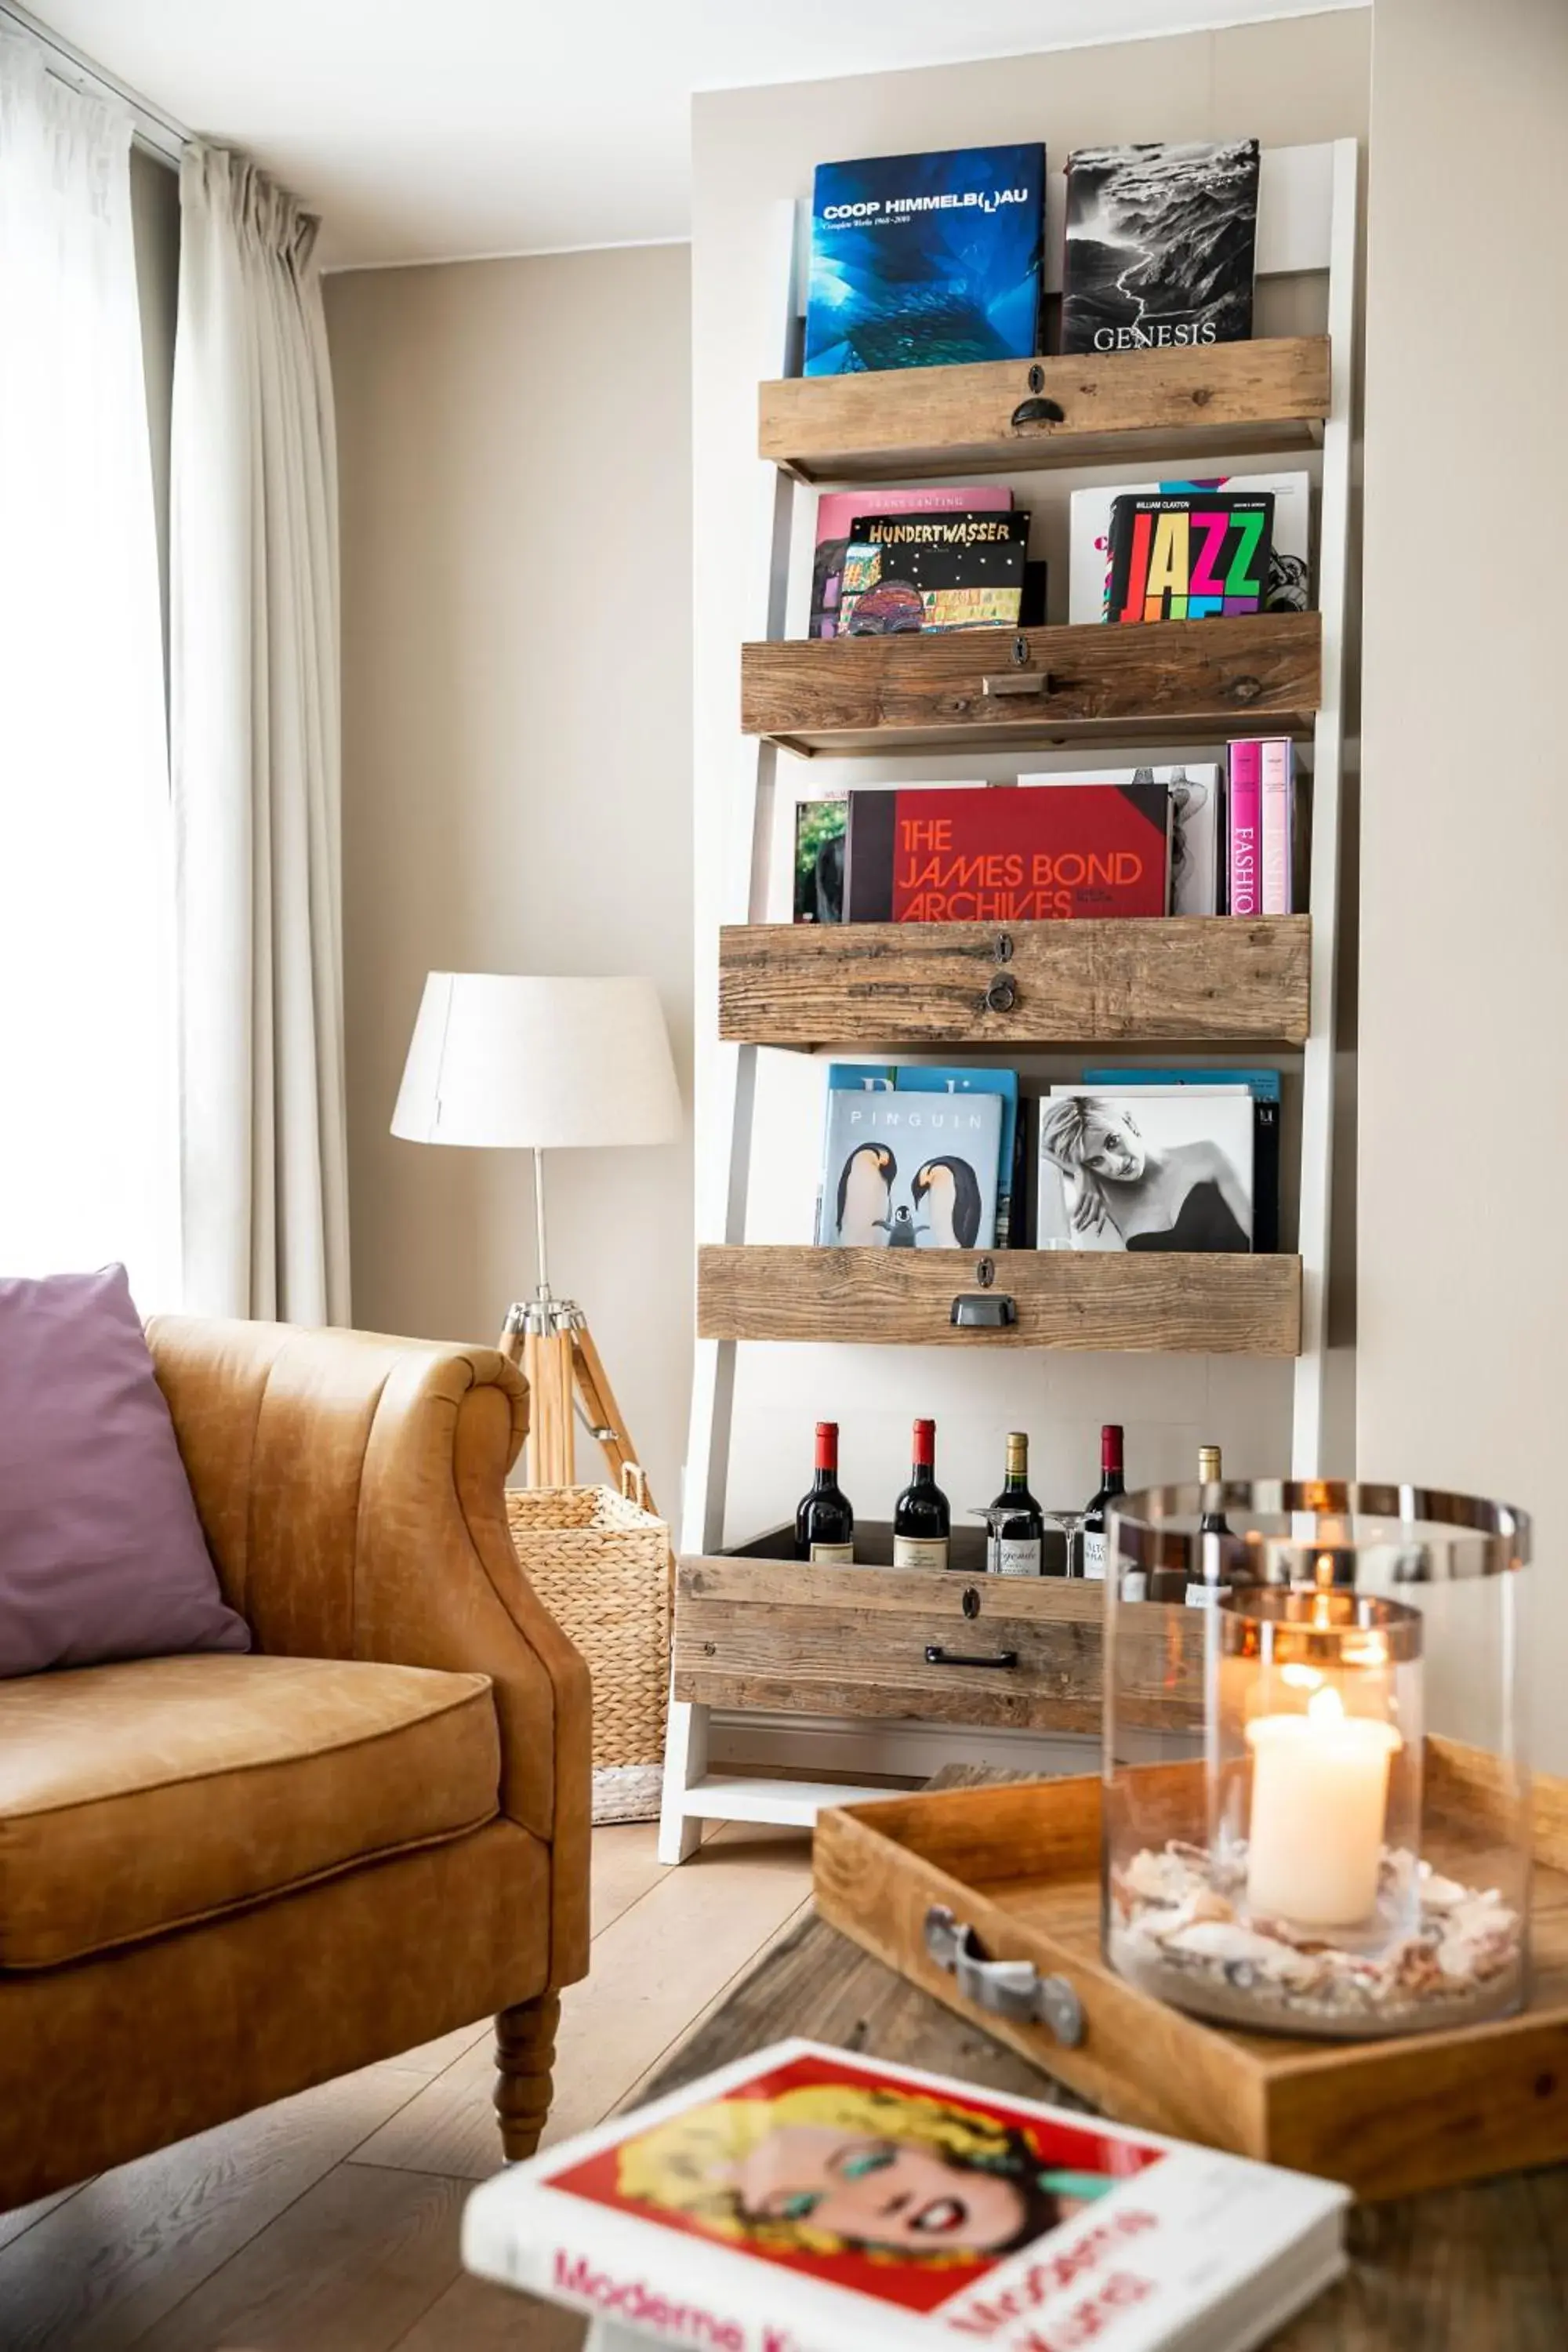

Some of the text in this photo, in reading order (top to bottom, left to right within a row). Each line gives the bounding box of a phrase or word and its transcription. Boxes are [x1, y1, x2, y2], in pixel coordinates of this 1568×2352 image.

[823, 188, 1028, 220] COOP HIMMELB(L)AU
[1094, 322, 1216, 350] GENESIS
[869, 522, 1010, 543] HUNDERTWASSER
[1120, 512, 1265, 623] JAZZ
[900, 819, 953, 851] THE
[899, 853, 1142, 888] JAMES BOND
[902, 891, 1073, 921] ARCHIVES
[850, 1110, 982, 1130] PINGUIN
